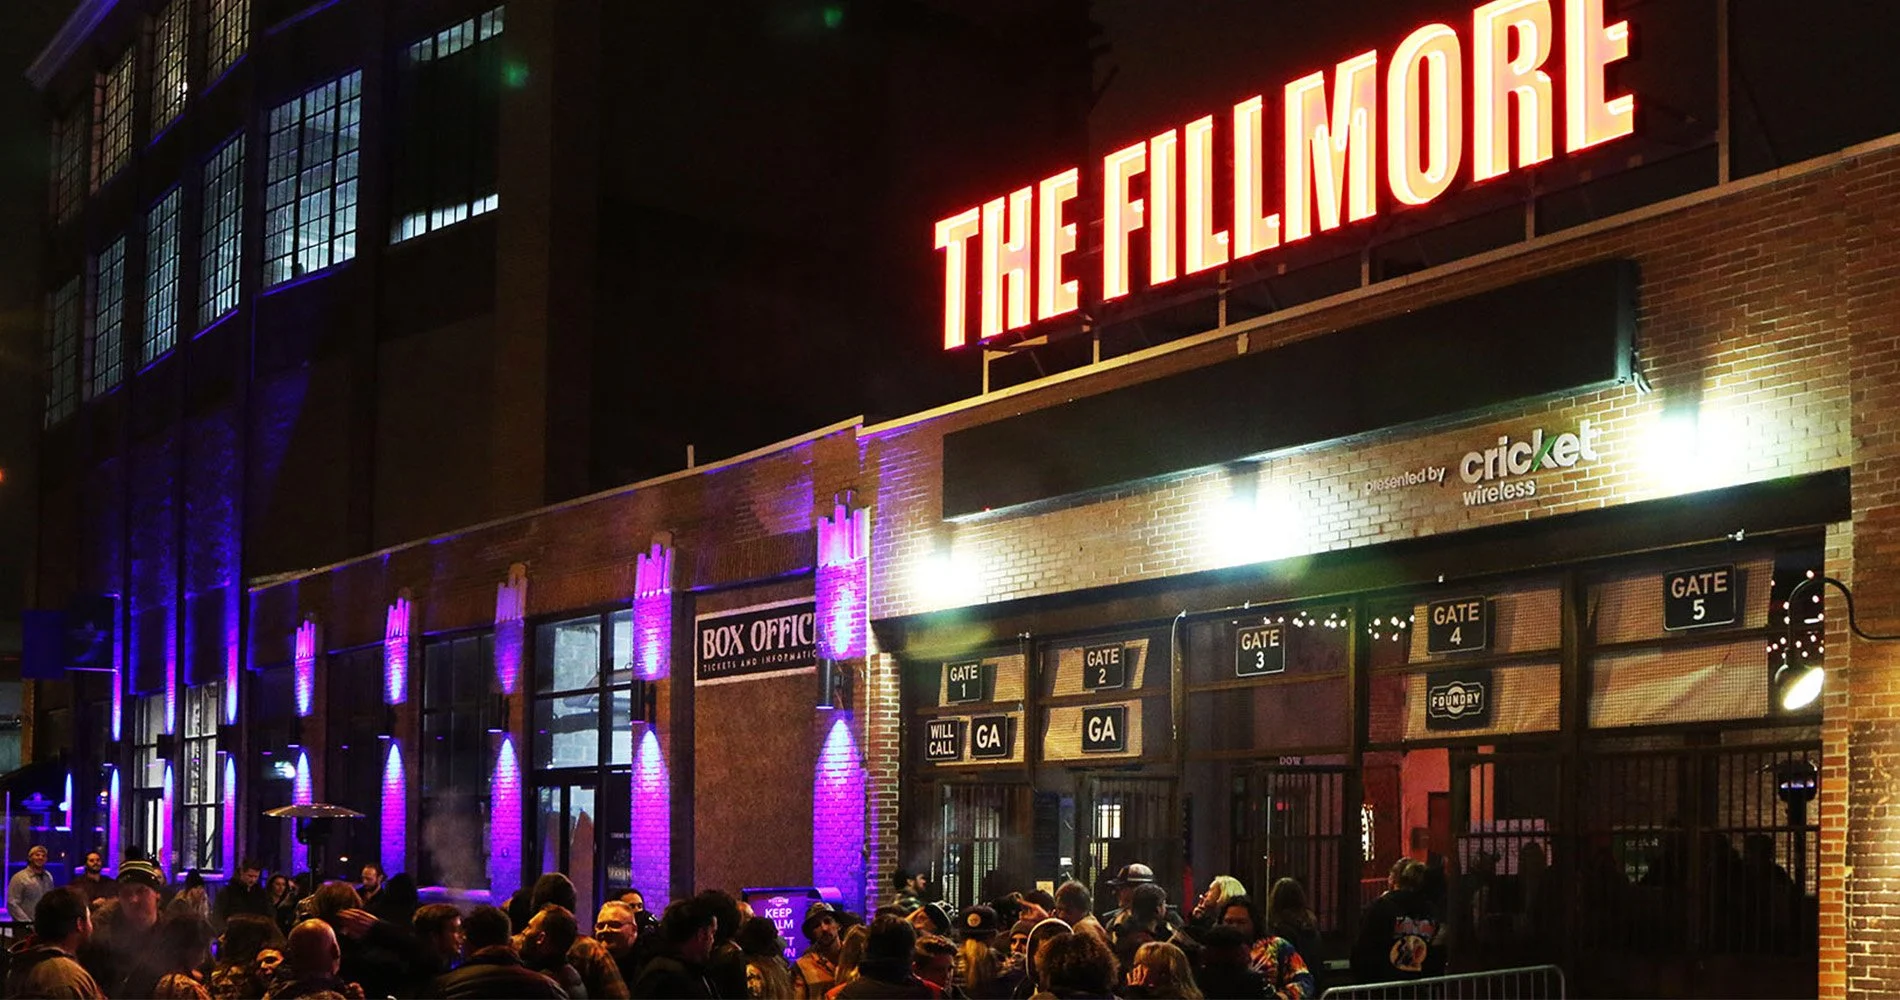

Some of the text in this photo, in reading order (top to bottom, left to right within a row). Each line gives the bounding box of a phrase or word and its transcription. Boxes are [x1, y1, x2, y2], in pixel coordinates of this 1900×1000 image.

[934, 0, 1634, 351] THE FILLMORE
[1459, 419, 1601, 484] cricket
[1365, 466, 1446, 496] presented by
[1463, 479, 1537, 507] wireless
[1671, 570, 1728, 599] GATE
[1433, 602, 1480, 626] GATE
[1692, 599, 1705, 621] 5
[703, 613, 817, 661] BOX OFFIC
[1241, 629, 1279, 651] GATE
[1450, 626, 1462, 645] 4
[703, 663, 737, 673] TICKETS
[740, 657, 757, 668] AND
[1087, 648, 1120, 667] GATE
[1255, 651, 1265, 669] 3
[949, 664, 978, 682] GATE
[1098, 668, 1107, 684] 2
[961, 683, 967, 698] 1
[1432, 692, 1480, 708] FOUNDRY
[930, 724, 954, 739] WILL
[976, 724, 1001, 748] GA
[1088, 716, 1116, 742] GA
[929, 740, 955, 756] CALL
[765, 908, 792, 919] KEEP
